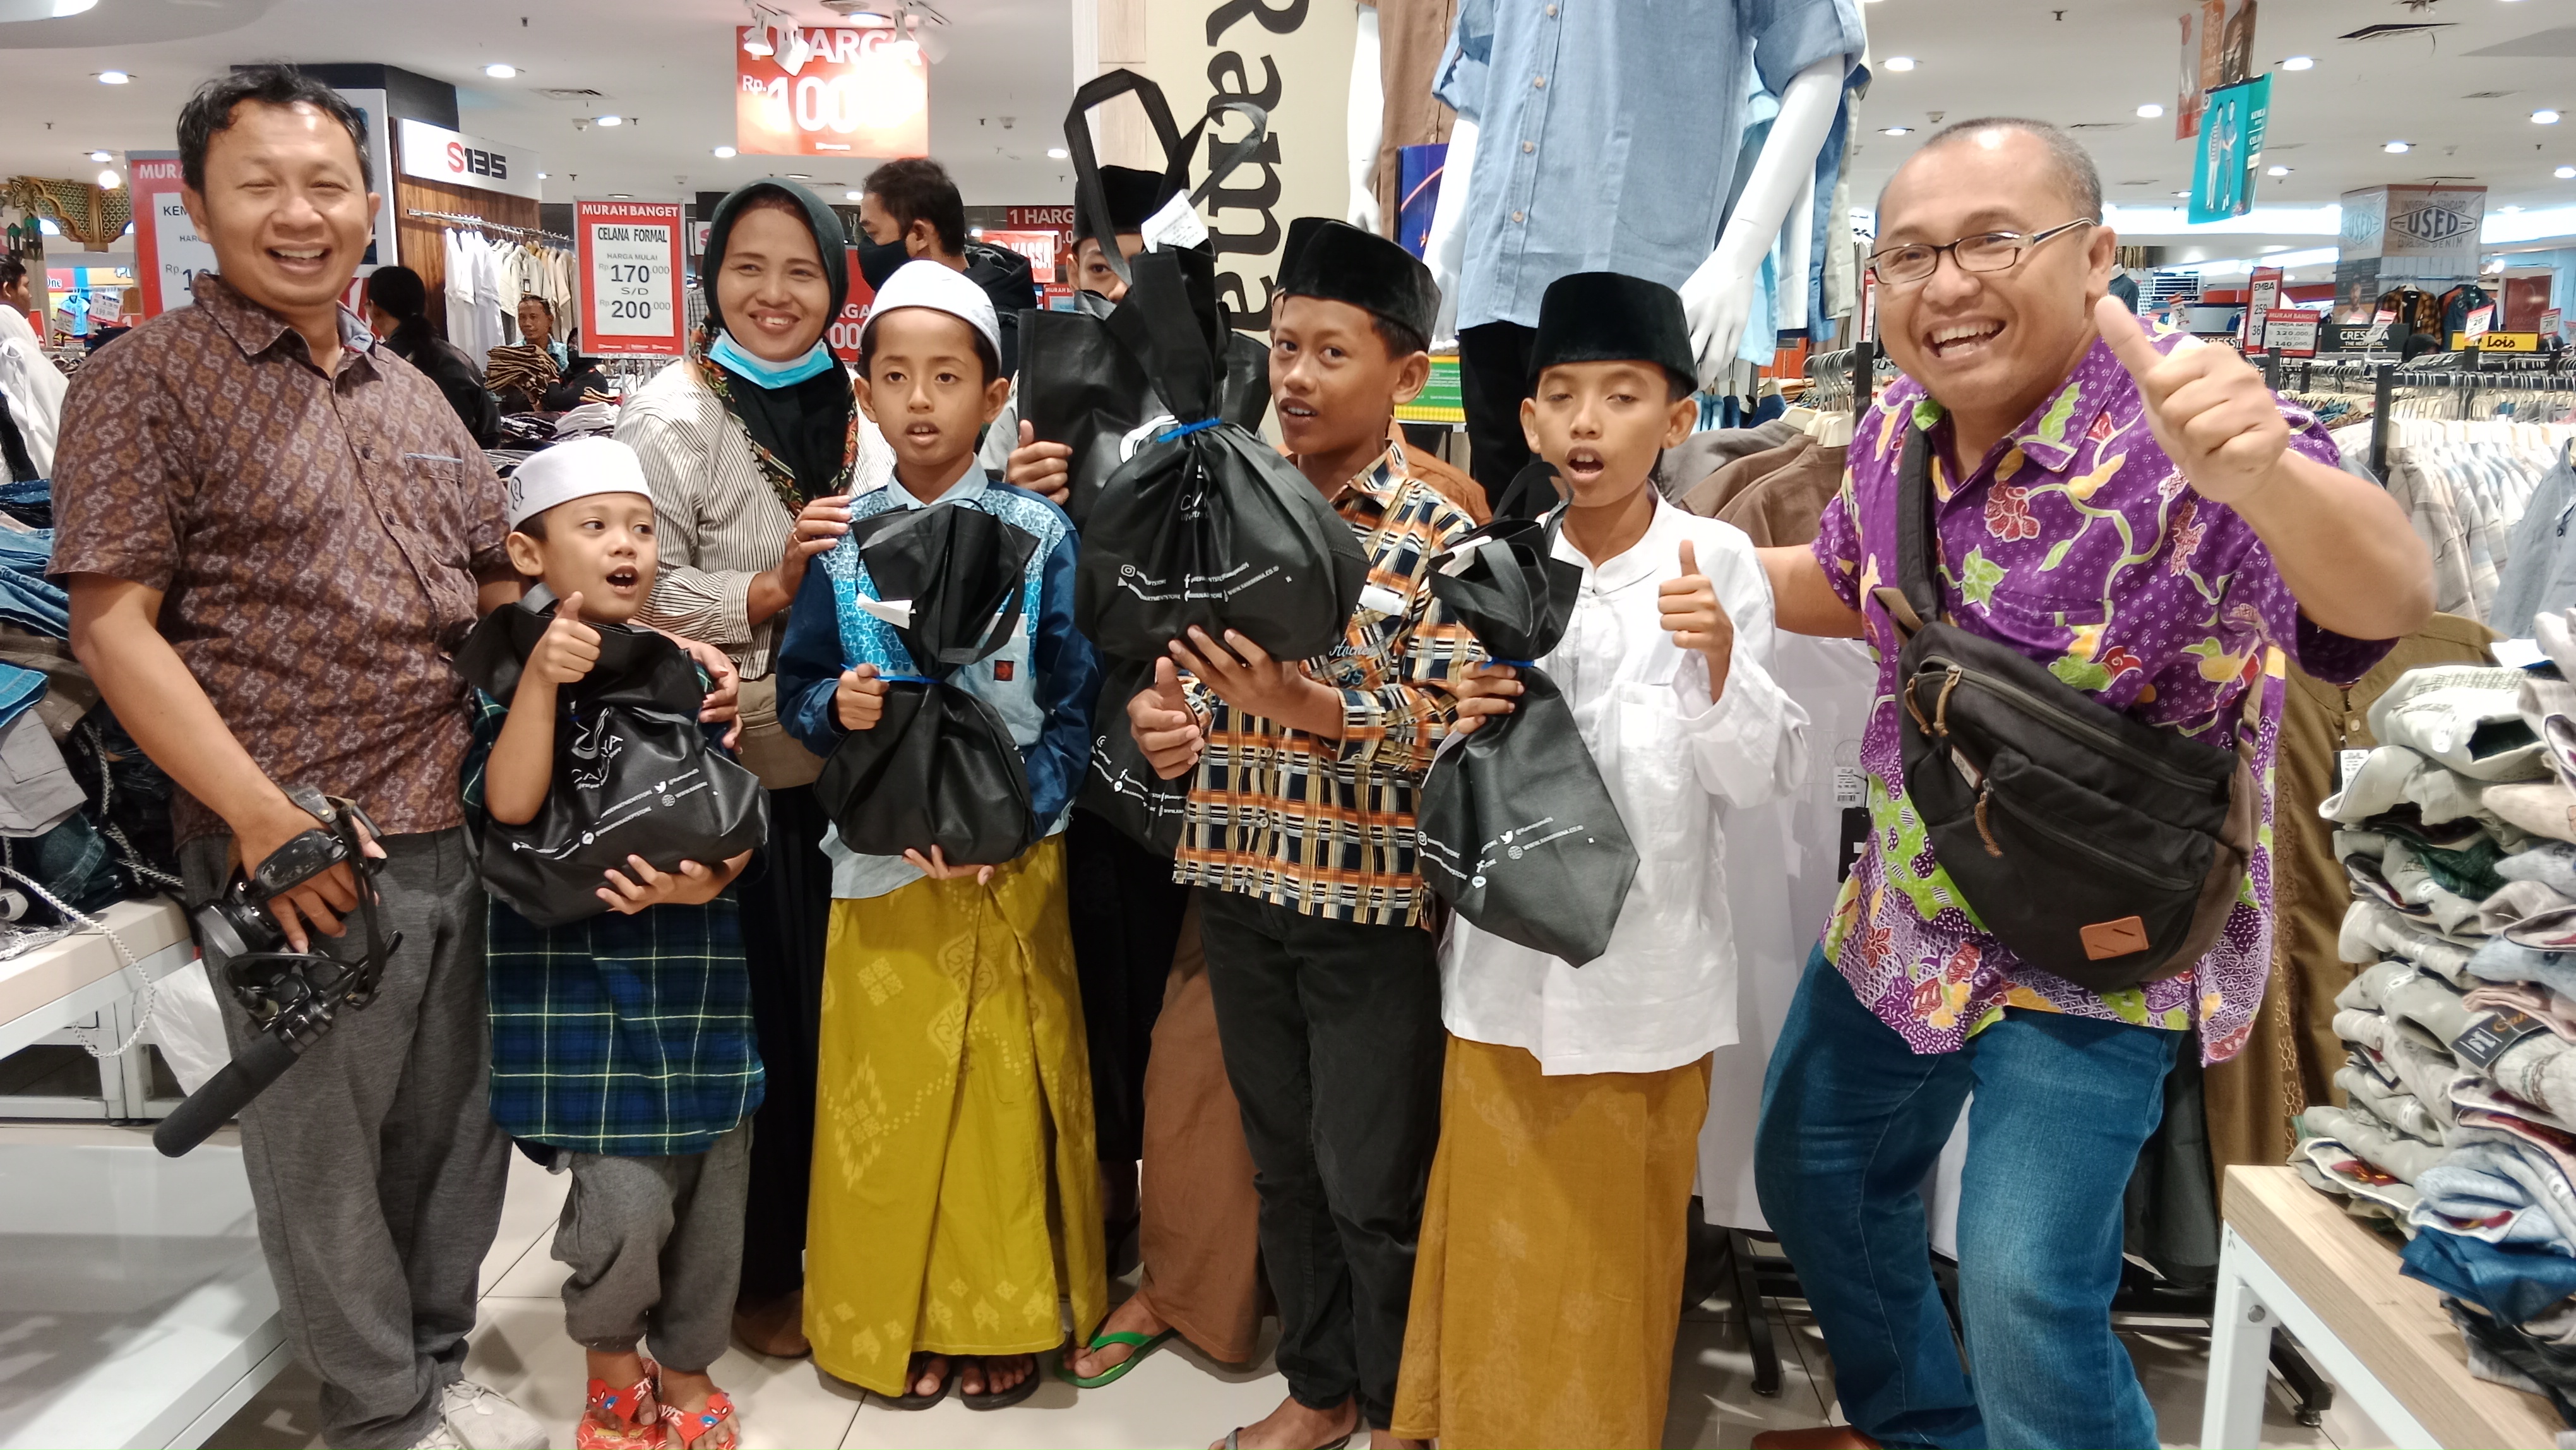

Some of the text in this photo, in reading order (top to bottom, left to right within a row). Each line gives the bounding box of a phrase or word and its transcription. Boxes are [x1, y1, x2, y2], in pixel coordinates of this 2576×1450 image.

[447, 142, 507, 179] S135
[582, 205, 678, 217] MURAH BANGET
[2407, 208, 2459, 238] USED
[598, 227, 667, 243] CELANA FORMAL
[2254, 282, 2275, 291] EMBA
[2340, 331, 2389, 341] CRESA
[2486, 335, 2515, 348] Lois
